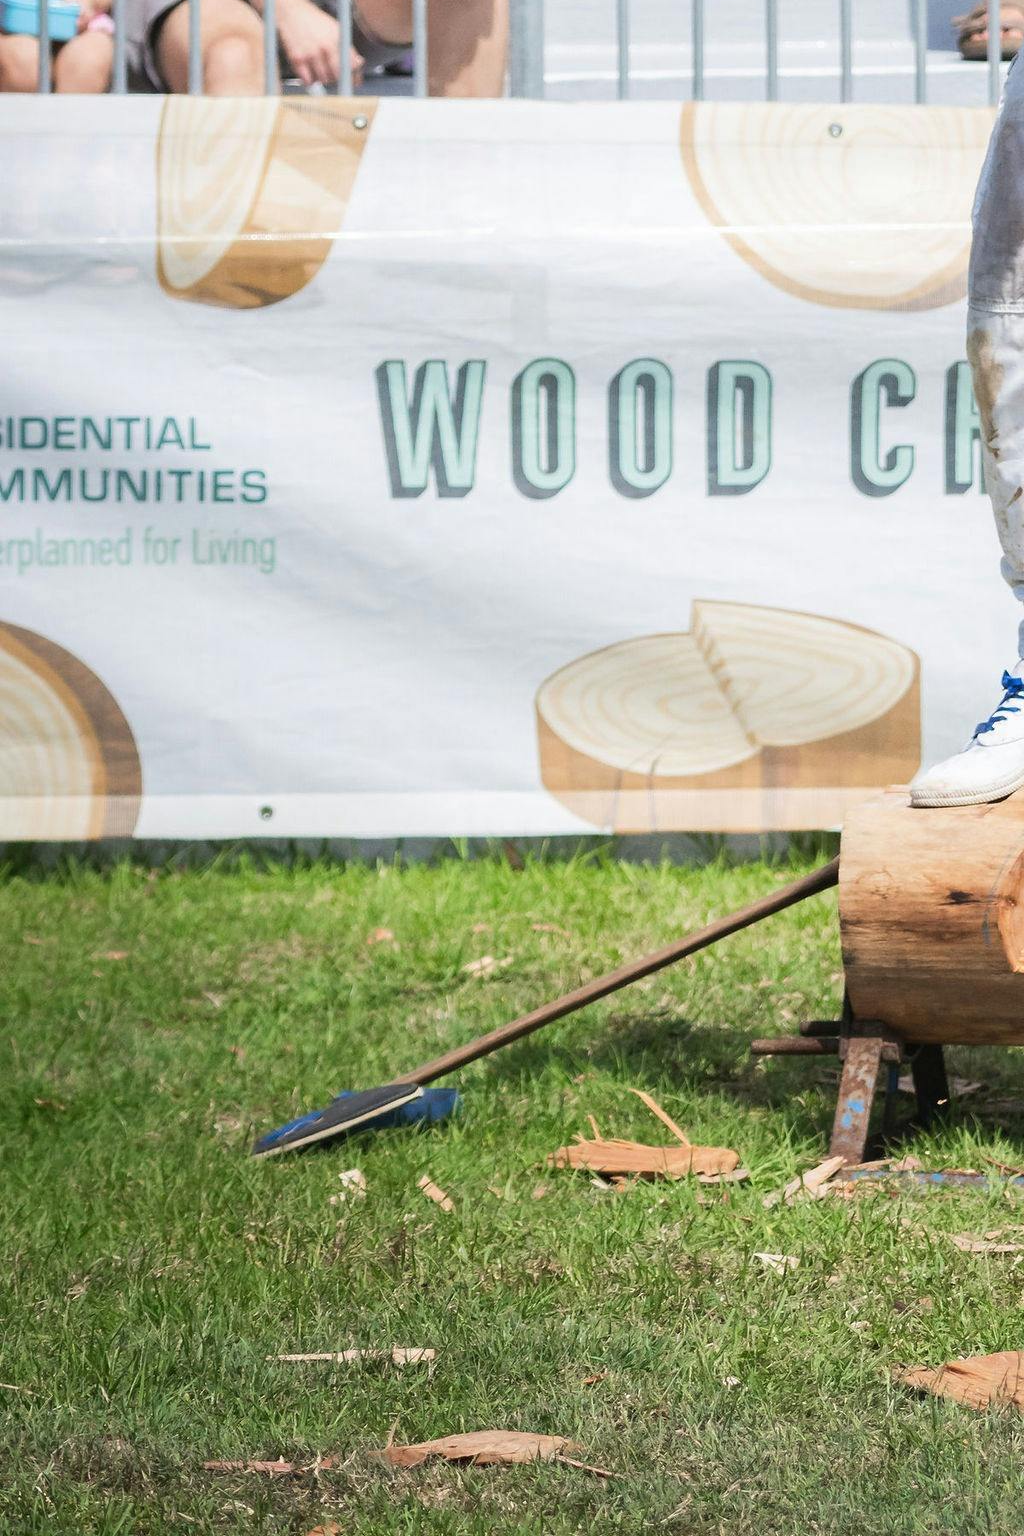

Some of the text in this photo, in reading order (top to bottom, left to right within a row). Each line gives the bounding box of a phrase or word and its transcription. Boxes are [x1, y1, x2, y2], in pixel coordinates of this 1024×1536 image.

[0, 417, 211, 450] IDENTIAL
[375, 358, 772, 500] WOOD
[0, 527, 276, 575] rplanned for Living
